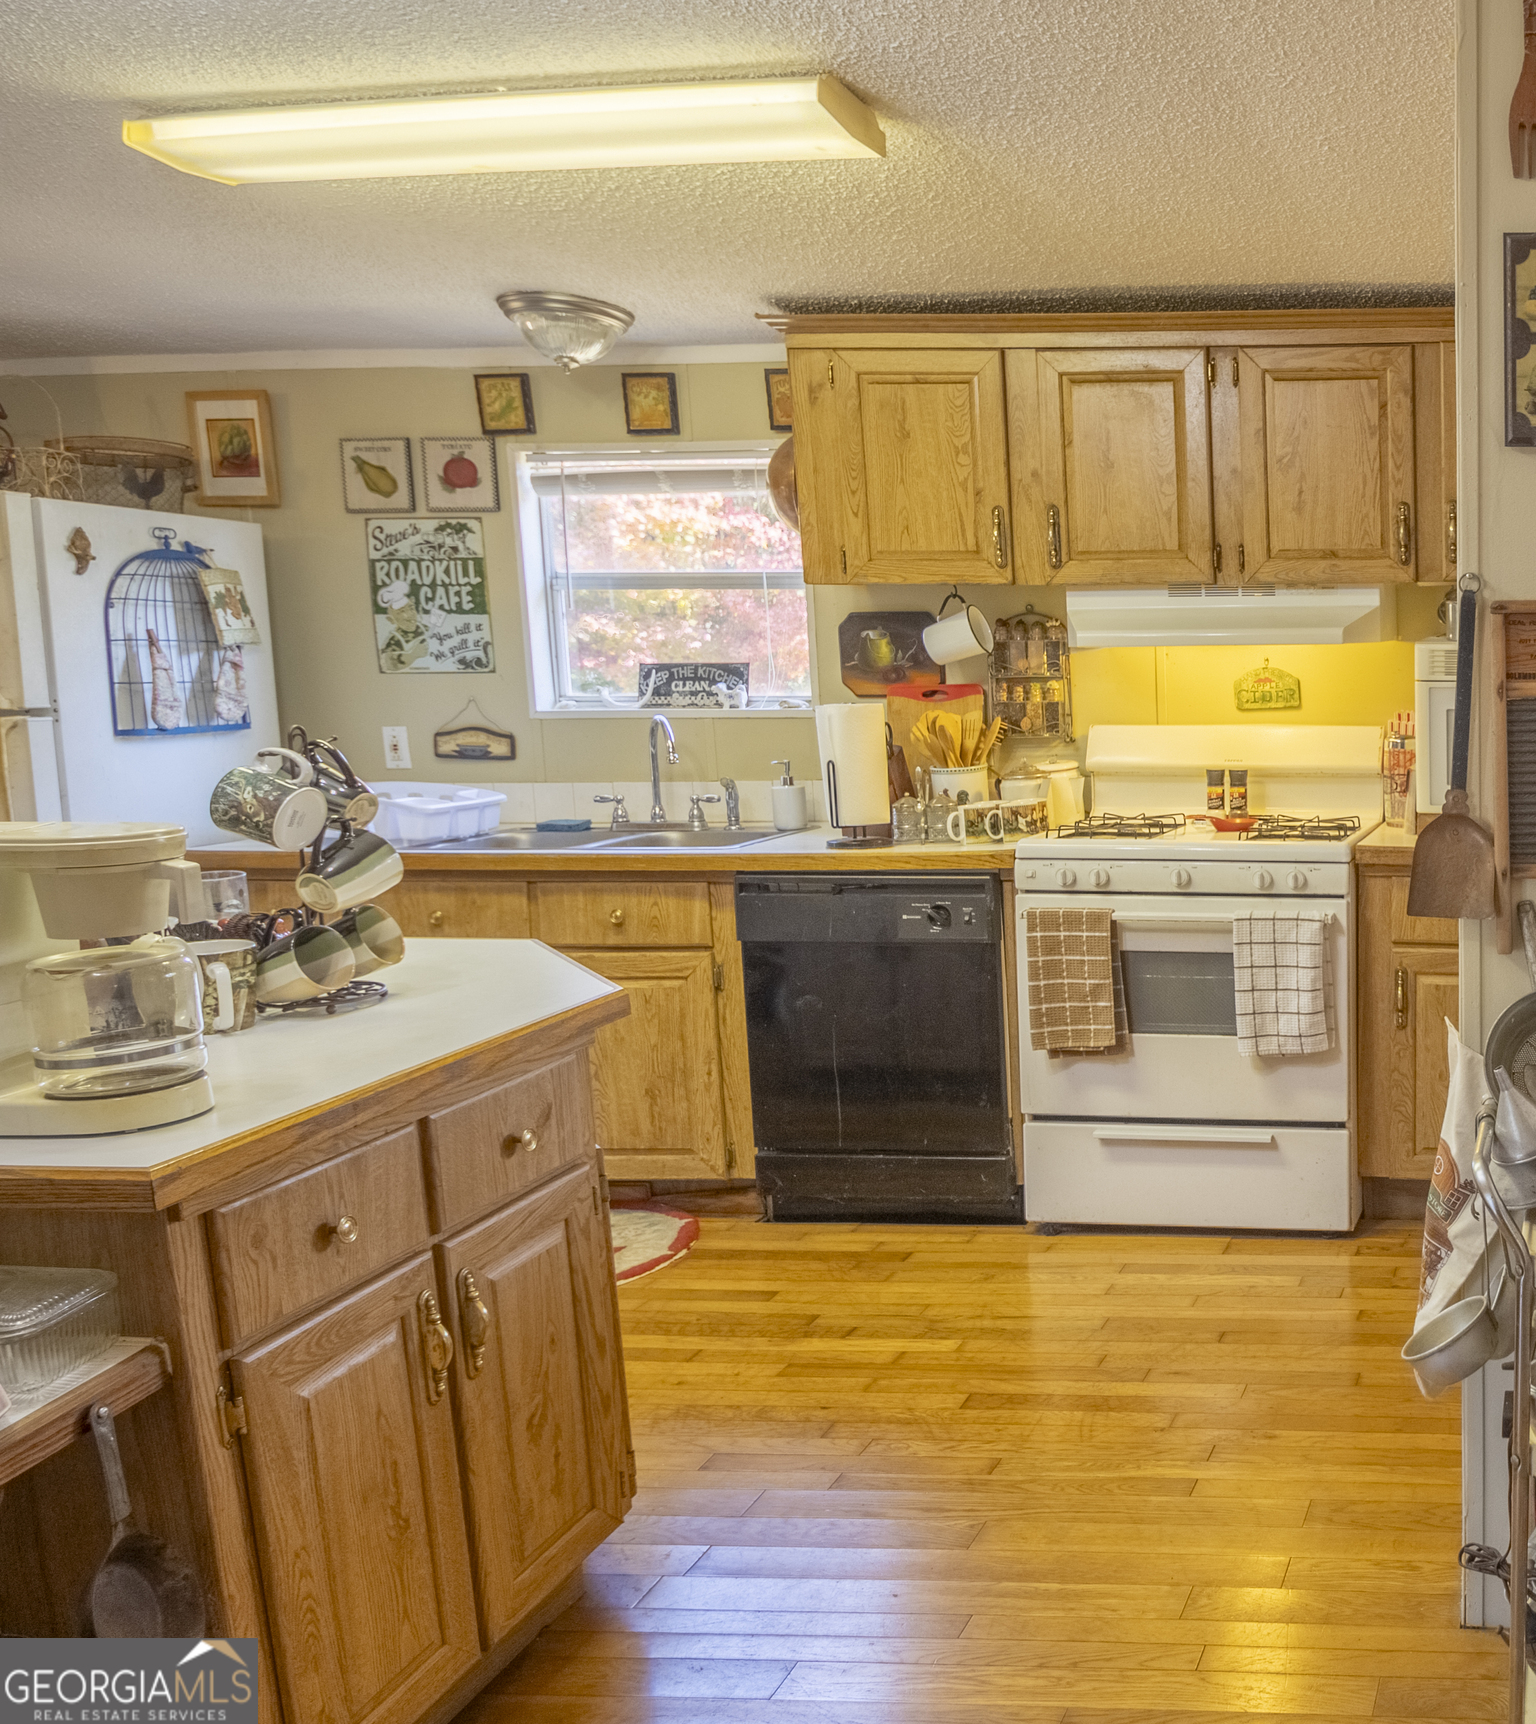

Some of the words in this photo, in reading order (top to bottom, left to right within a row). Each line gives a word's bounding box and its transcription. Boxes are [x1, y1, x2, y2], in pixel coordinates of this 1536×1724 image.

[372, 523, 421, 552] Steve's
[375, 560, 483, 586] ROADKILL
[420, 585, 475, 611] CAFE
[455, 622, 473, 637] kill
[475, 622, 484, 633] it
[430, 649, 448, 662] We
[448, 637, 470, 658] grill
[640, 671, 670, 693] KEP
[671, 665, 695, 680] THE
[697, 666, 746, 690] KITCHE
[671, 680, 711, 691] CLEAN.
[1250, 682, 1281, 690] APPLE
[1237, 689, 1297, 704] CIDER
[1427, 1194, 1448, 1217] STORE
